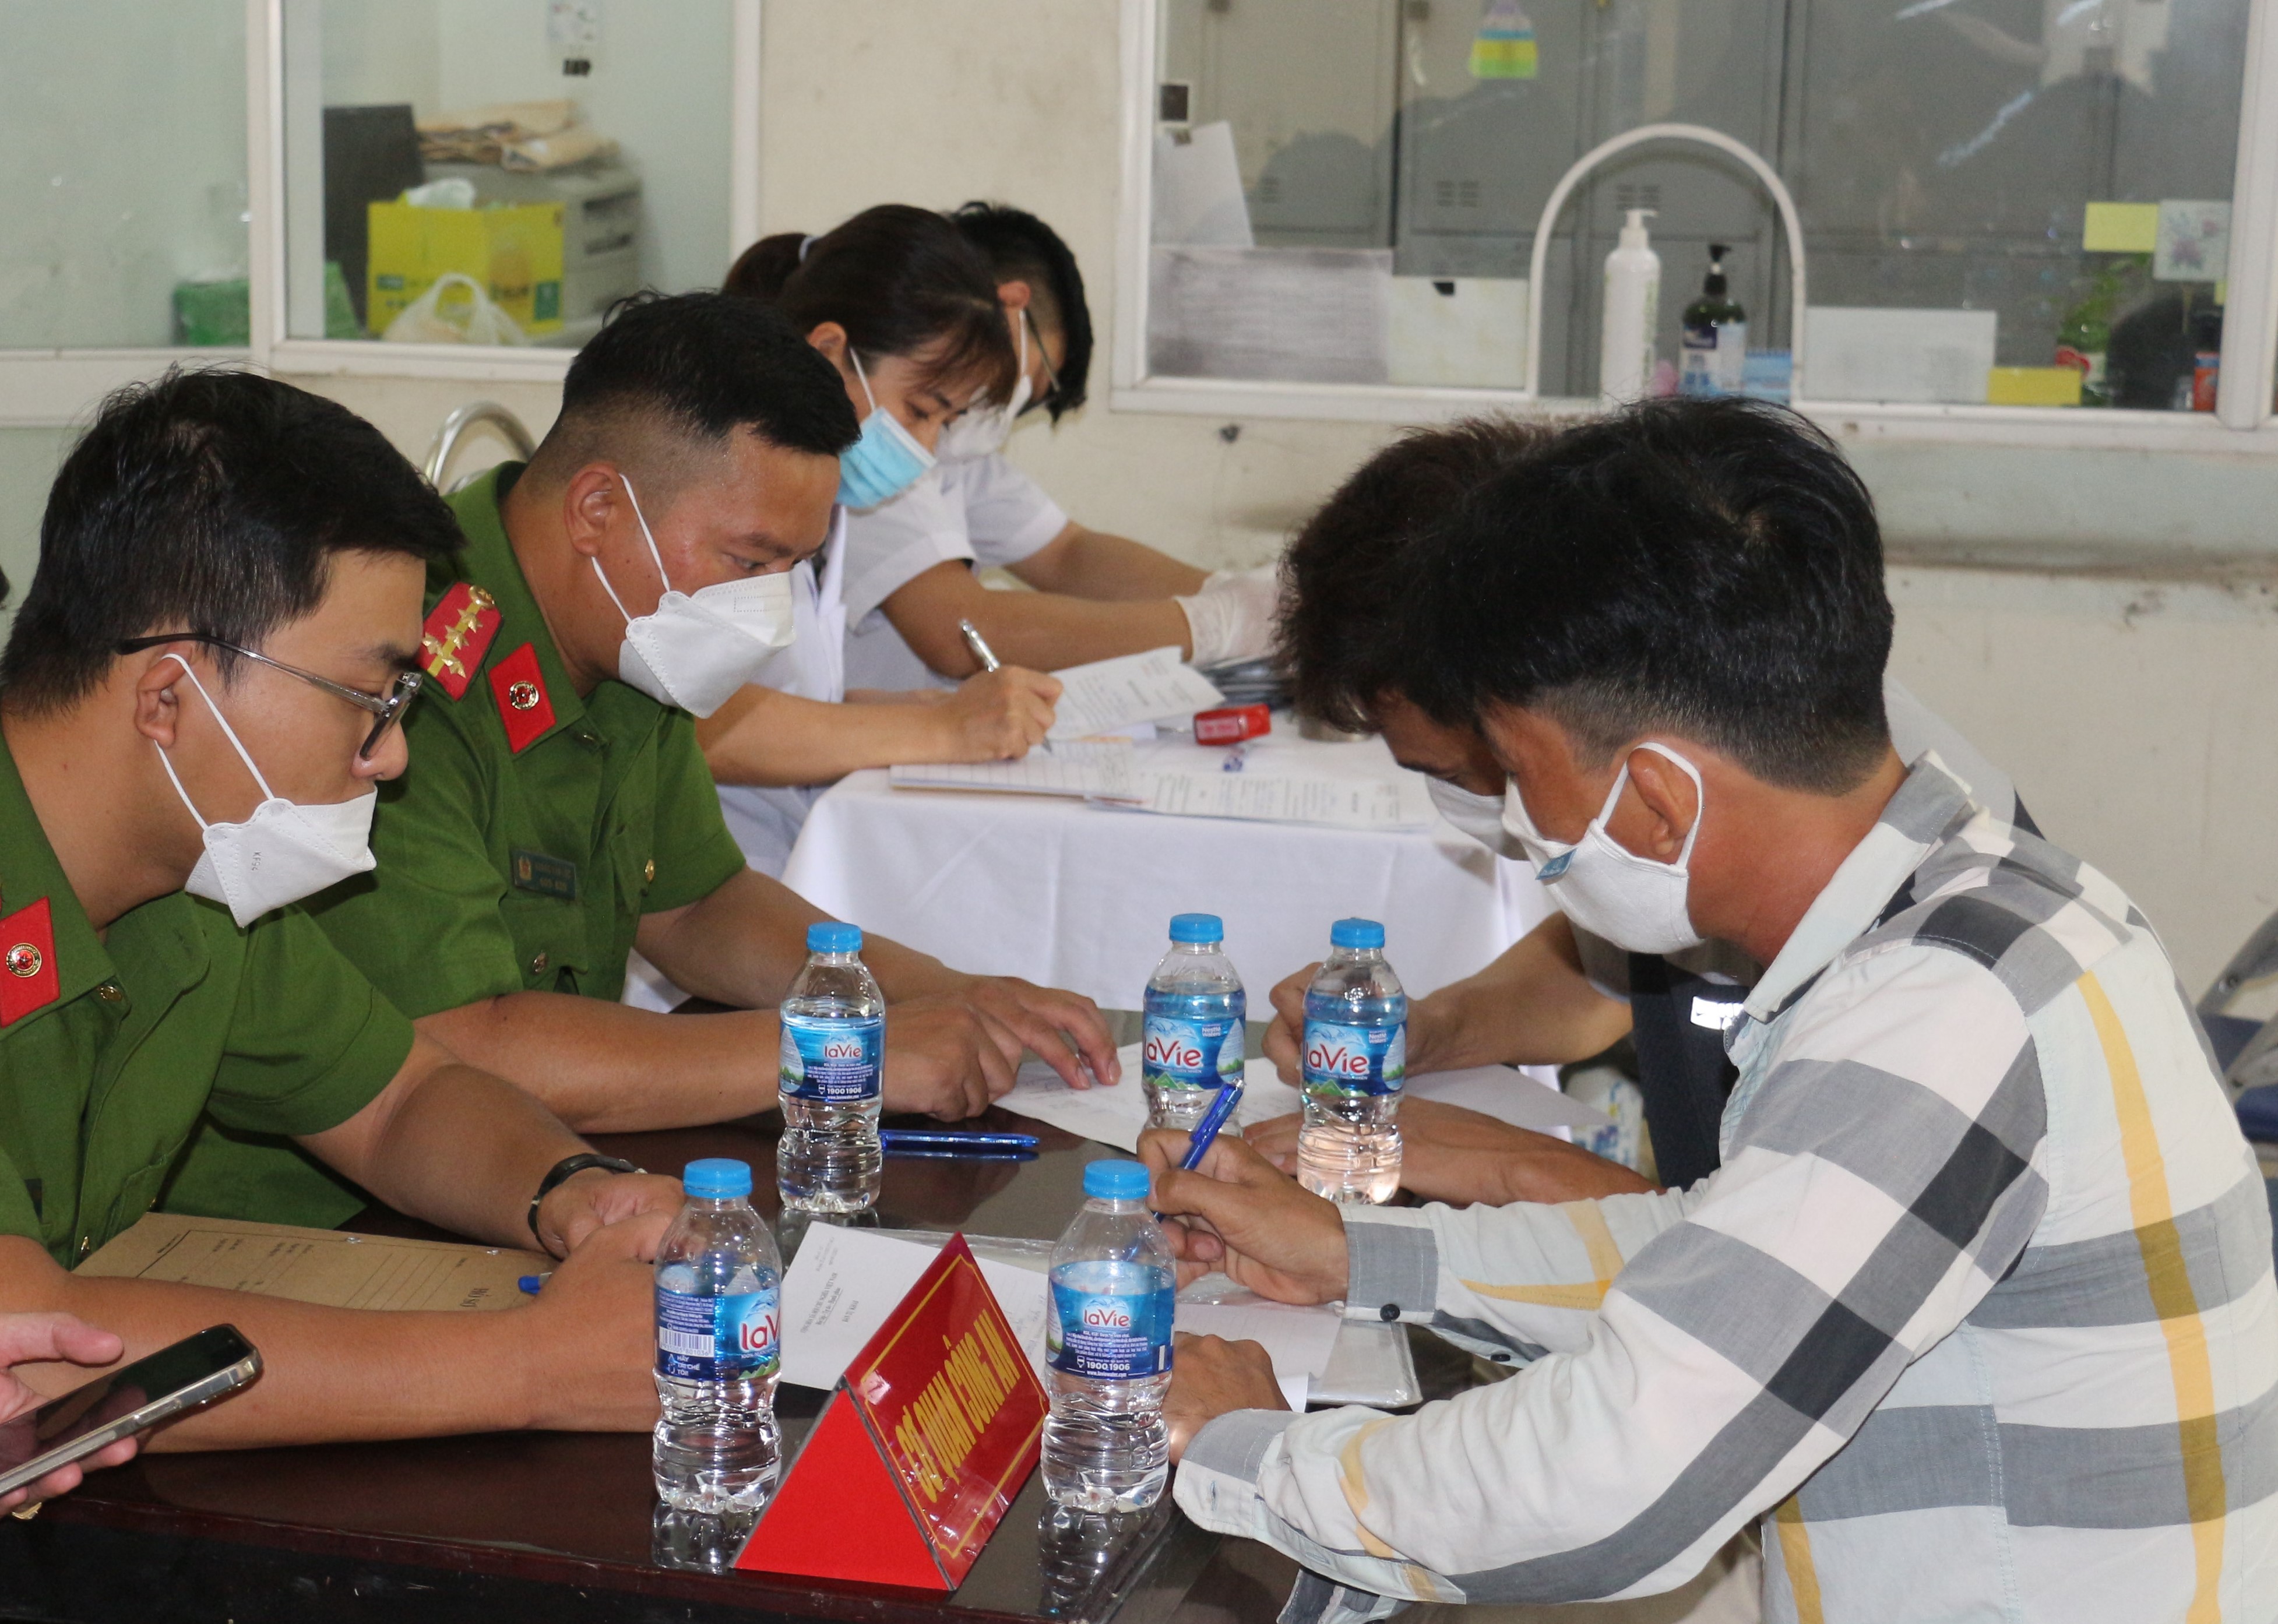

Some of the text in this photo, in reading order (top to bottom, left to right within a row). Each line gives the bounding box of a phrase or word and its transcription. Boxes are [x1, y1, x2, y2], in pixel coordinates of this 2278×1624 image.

[824, 1044, 861, 1058] laVie
[1306, 1042, 1368, 1073] laVie
[845, 1086, 862, 1094] 1906
[1084, 1308, 1129, 1327] laVie
[1086, 1361, 1108, 1370] 1900
[895, 1309, 1020, 1503] CƠ QUAN CÔNG AN
